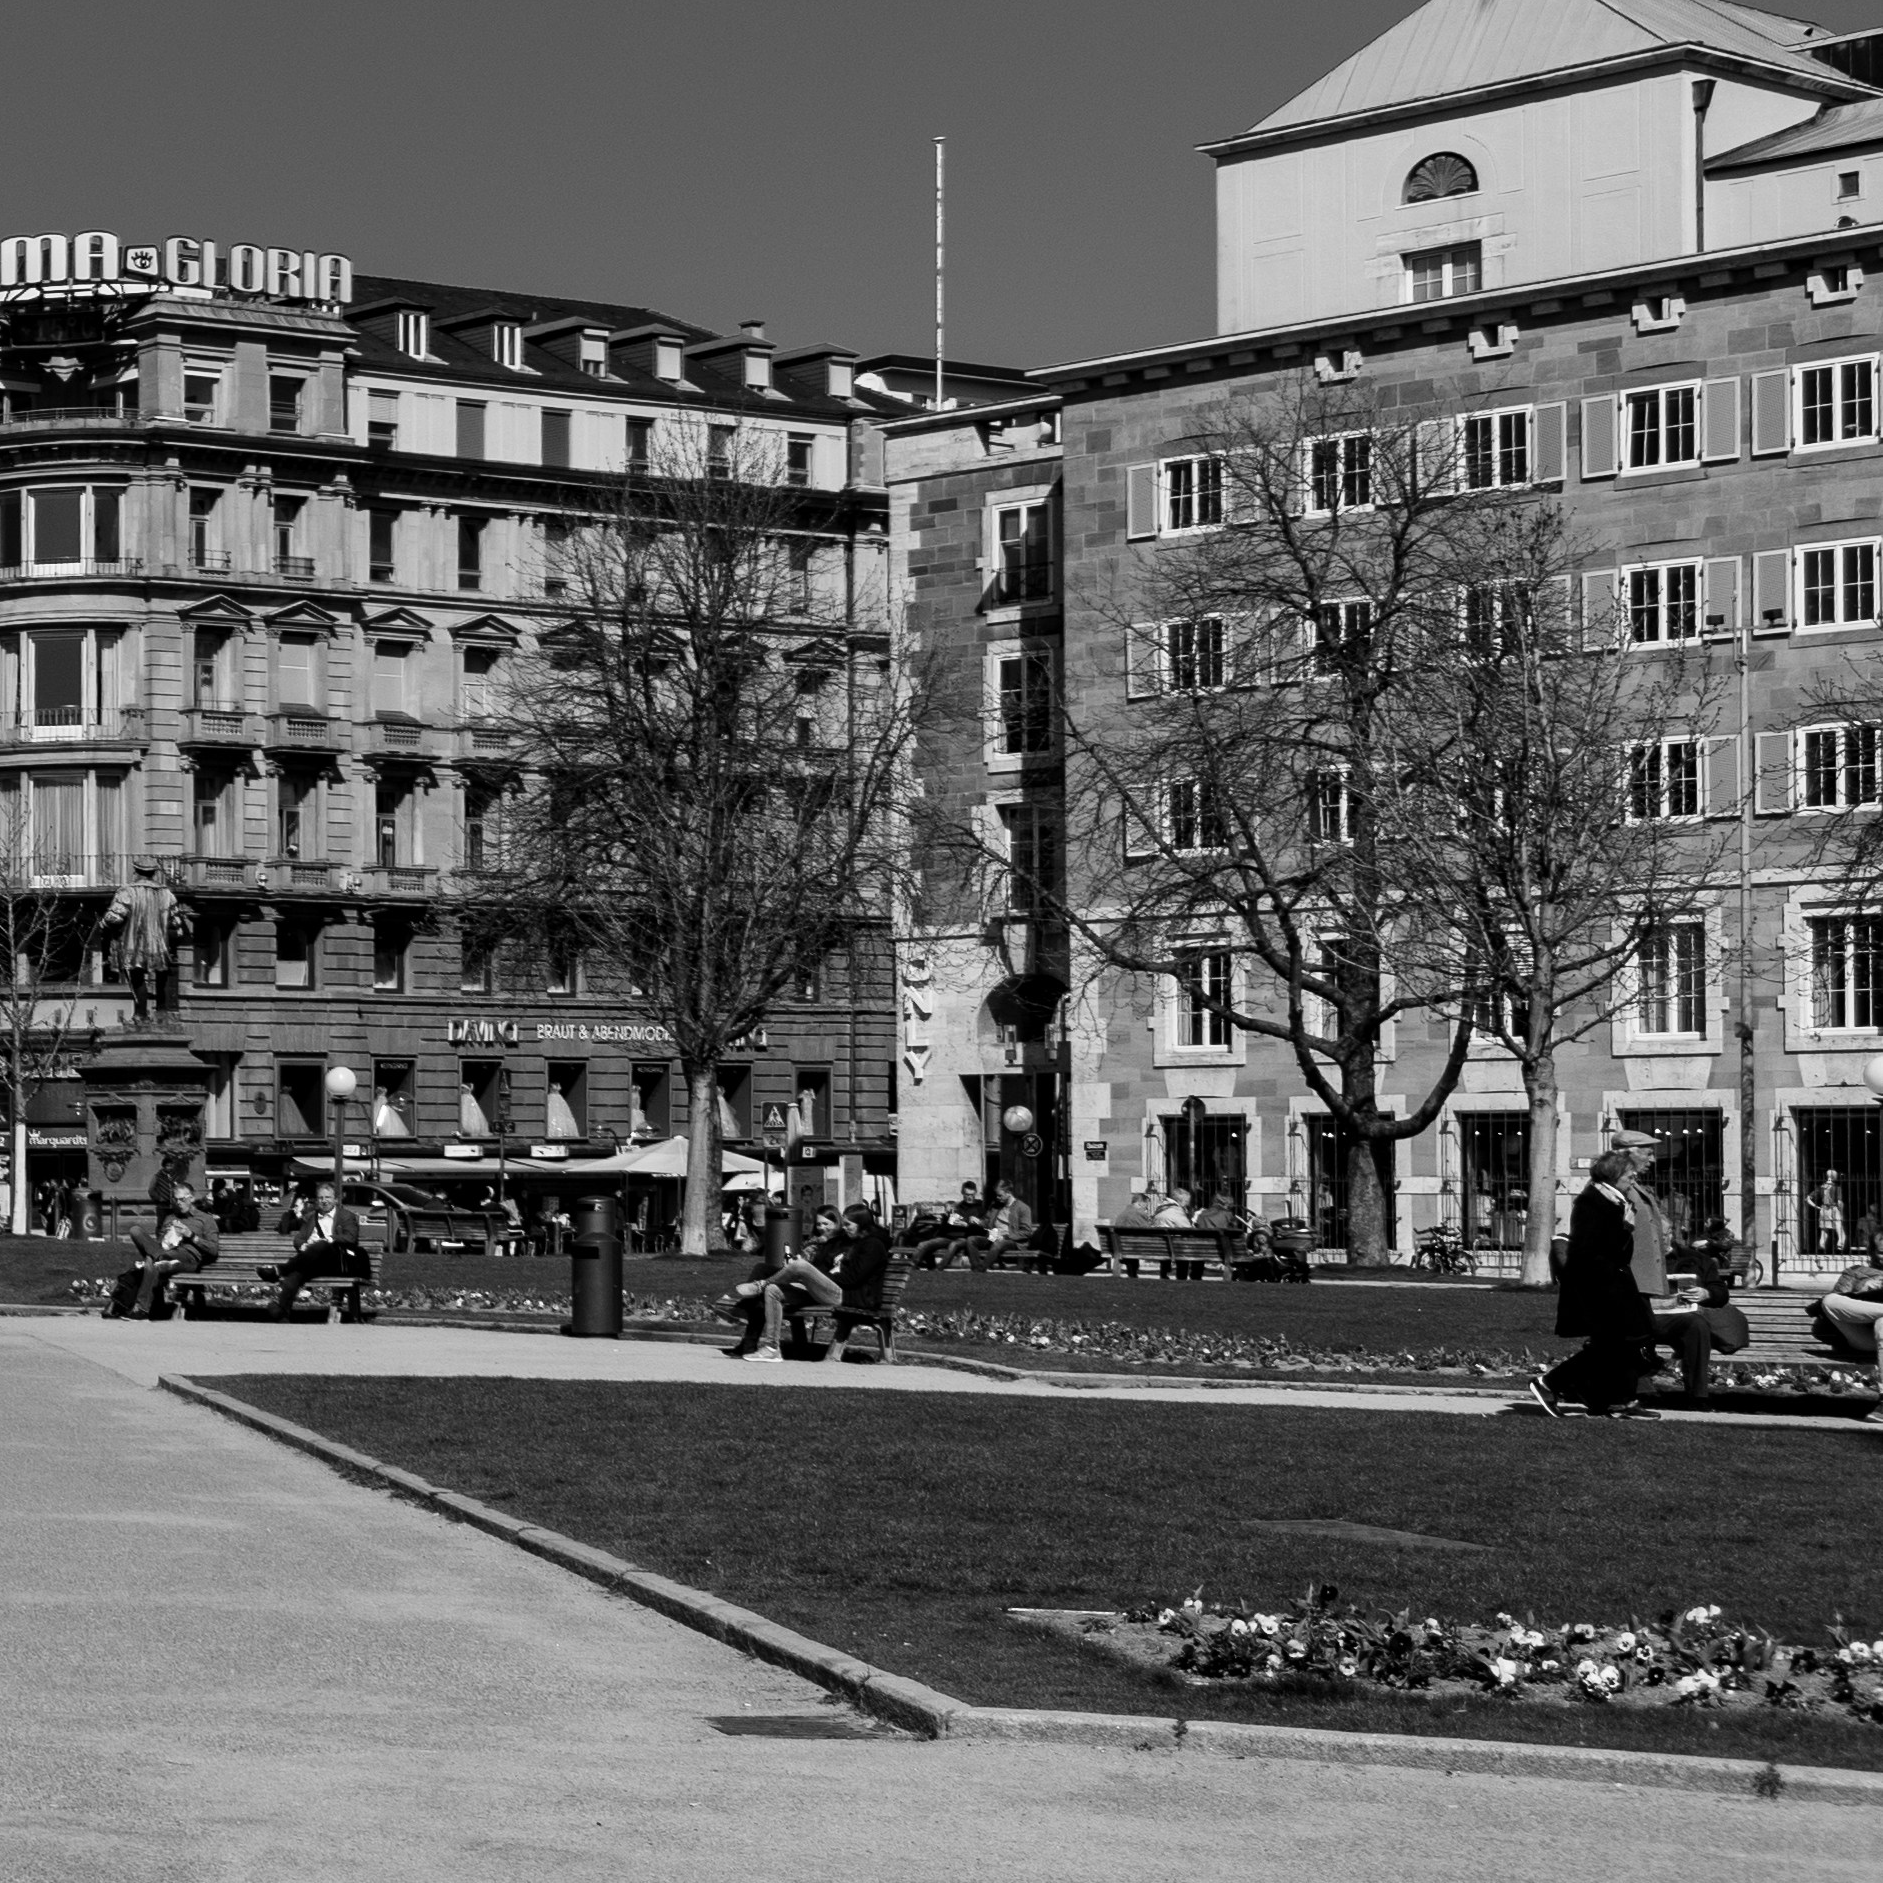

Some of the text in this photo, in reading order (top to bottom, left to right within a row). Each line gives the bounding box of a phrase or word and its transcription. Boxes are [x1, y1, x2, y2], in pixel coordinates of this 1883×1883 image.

[165, 236, 352, 304] GLORIA
[537, 1024, 575, 1040] BRAUT
[578, 1025, 589, 1040] &
